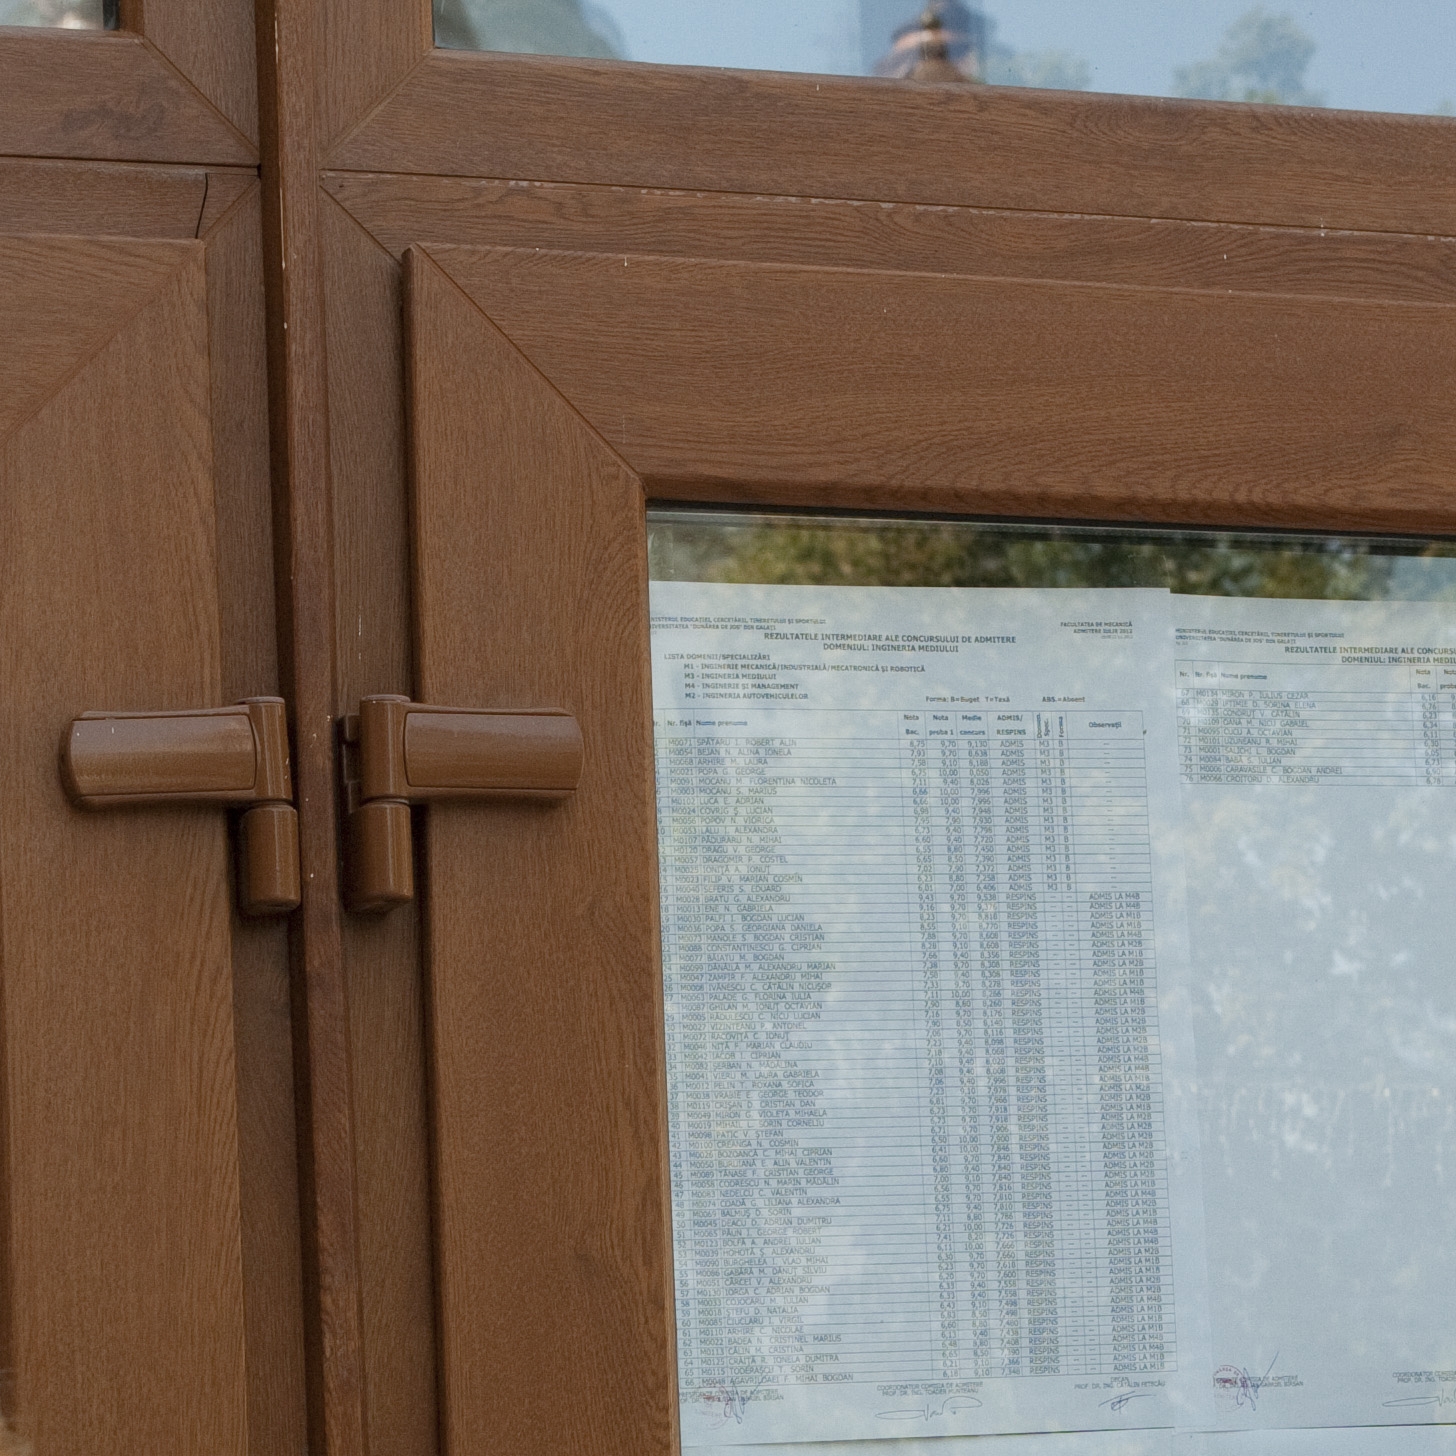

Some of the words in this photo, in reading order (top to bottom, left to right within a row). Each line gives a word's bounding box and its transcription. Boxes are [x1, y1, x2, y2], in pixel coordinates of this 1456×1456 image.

[763, 632, 818, 641] REZULTATELE
[821, 633, 882, 642] INTERMEDIARE
[884, 634, 899, 642] ALE
[901, 634, 959, 643] CONCURSULUI
[961, 635, 972, 644] DE
[974, 636, 1016, 644] ADMITERE
[822, 643, 869, 651] DOMENIUL:
[871, 644, 916, 652] INGINERIA
[917, 644, 959, 653] MEDIULUI
[1284, 647, 1337, 655] REZULTATELE
[1339, 647, 1398, 656] INTERMEDIARE
[1400, 648, 1414, 656] ALE
[663, 653, 685, 661] LISTA
[686, 651, 770, 661] DOMENII/SPECIALIZĂRI
[1341, 656, 1386, 664] DOMENIUL:
[1387, 656, 1430, 665] INGINERIA
